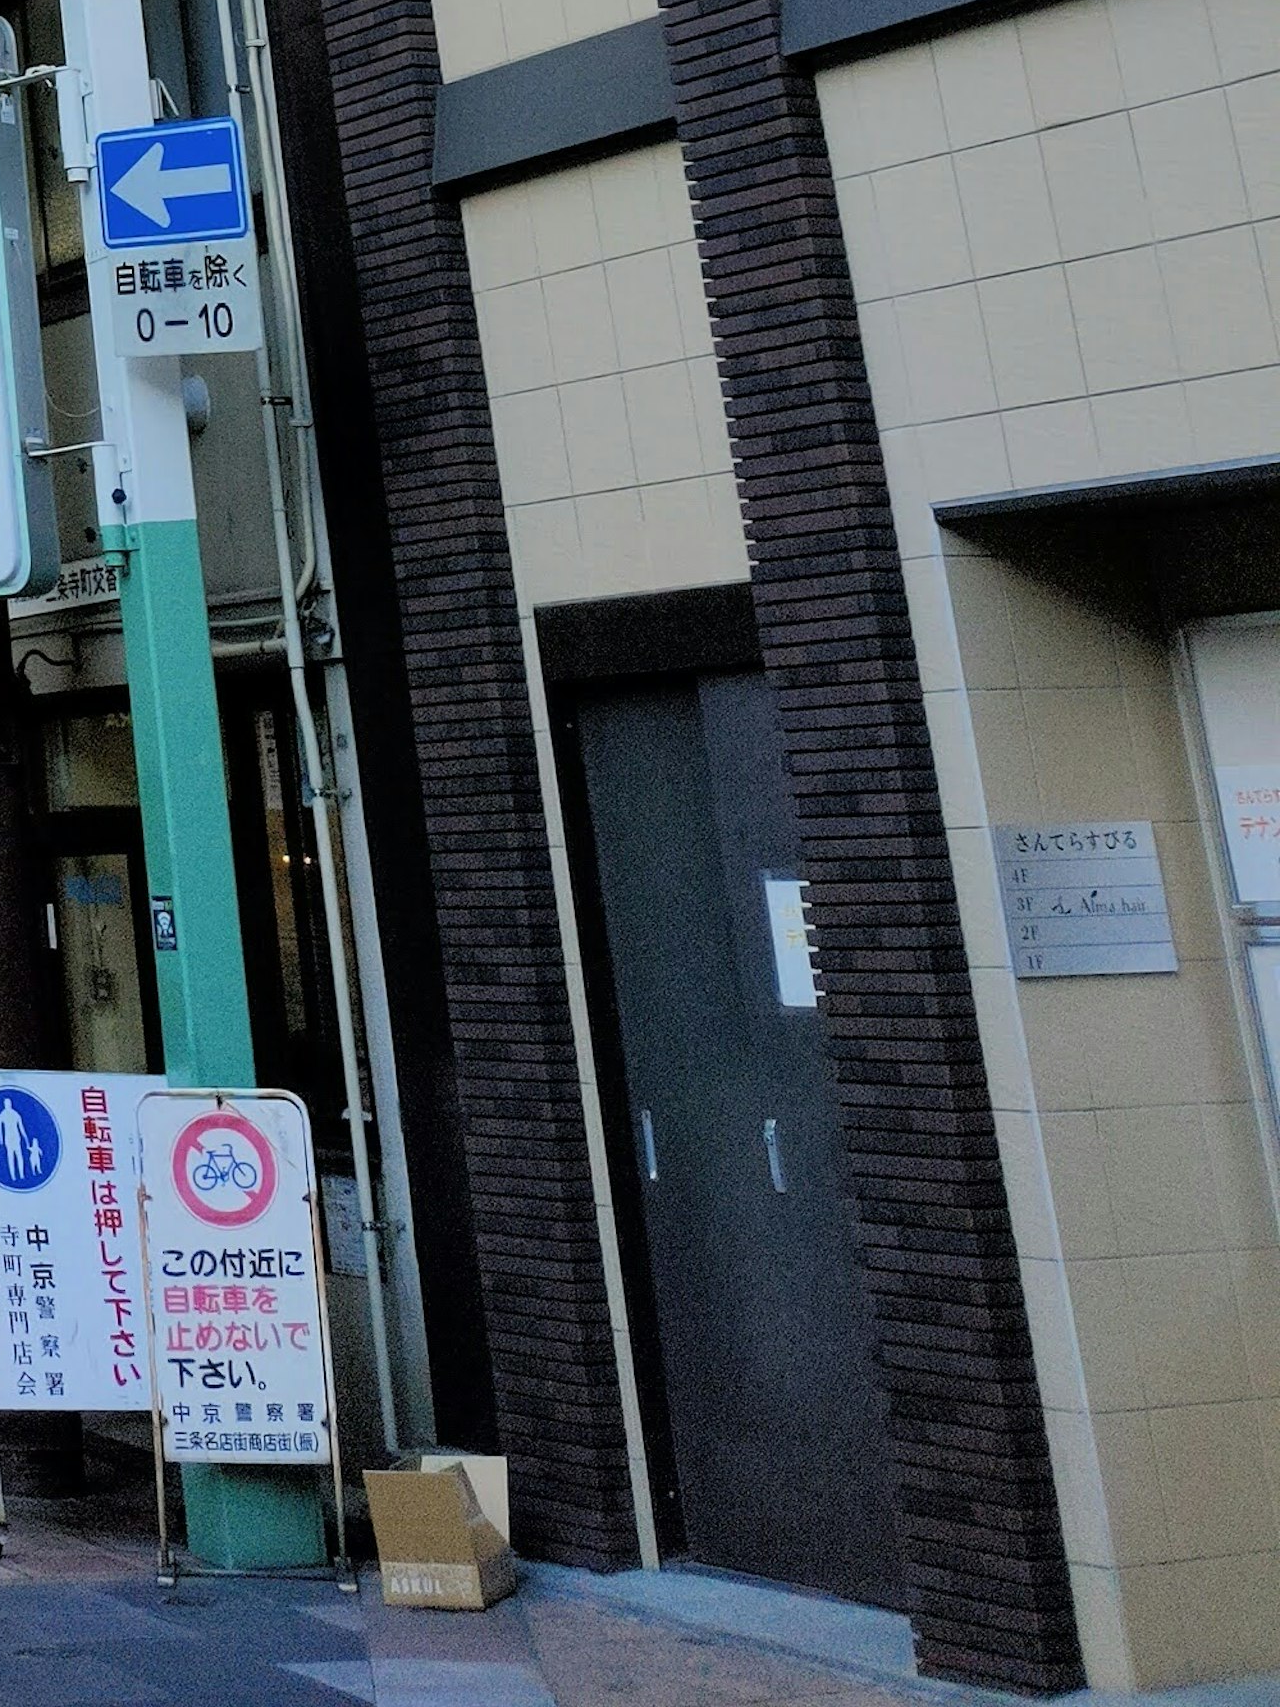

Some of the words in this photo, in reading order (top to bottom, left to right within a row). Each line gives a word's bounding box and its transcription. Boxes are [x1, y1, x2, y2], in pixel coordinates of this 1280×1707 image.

[116, 254, 247, 295] 自転車を除く
[1016, 830, 1137, 852] さんてらすびる
[81, 1085, 142, 1386] 自転車は押して下さい
[162, 1248, 305, 1279] この付近に
[0, 1224, 37, 1396] 寺町専門店会
[26, 1224, 64, 1396] 中京警察署
[164, 1285, 279, 1314] 自転車を
[166, 1321, 310, 1351] 止めないで
[168, 1358, 267, 1390] 下さい。
[172, 1402, 315, 1423] 中京警察署
